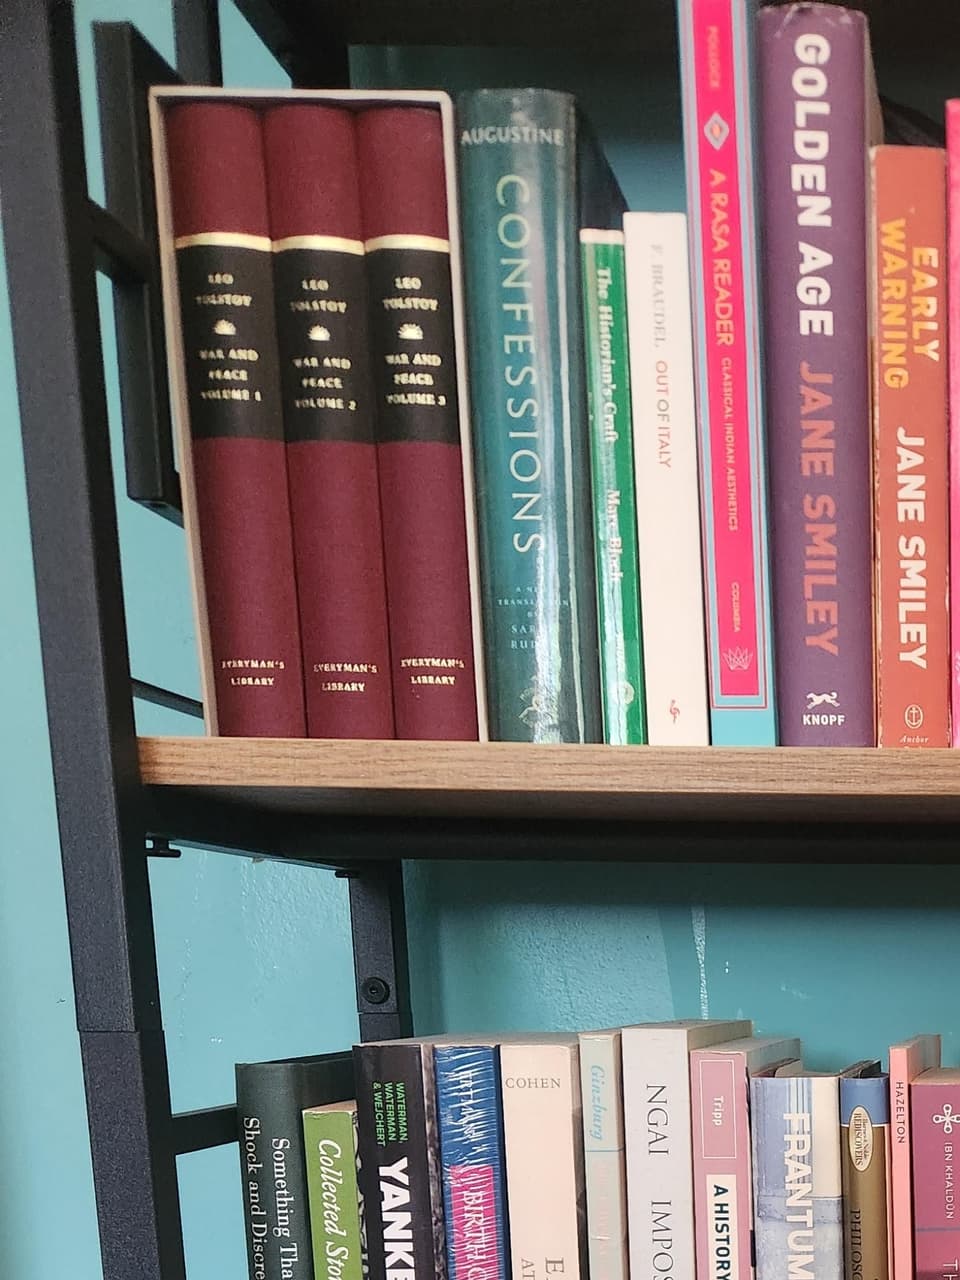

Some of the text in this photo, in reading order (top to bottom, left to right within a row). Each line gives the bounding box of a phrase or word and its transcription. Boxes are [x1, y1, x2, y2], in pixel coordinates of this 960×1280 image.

[460, 126, 565, 147] AUGUSTINE
[791, 33, 834, 336] GOLDEN AGE
[880, 218, 909, 389] WARNING
[912, 247, 939, 362] EARLY
[495, 174, 546, 553] CONFESSIONS
[800, 361, 839, 656] JANE SMILEY
[897, 427, 927, 670] JANE SMILEY
[803, 714, 845, 726] KNOPF
[384, 1082, 397, 1141] WATERMAN
[505, 1078, 561, 1089] COHEN
[646, 1083, 669, 1155] NGAI
[712, 1096, 724, 1126] Tripp
[896, 1082, 906, 1143] HAZELTON
[272, 1138, 295, 1237] Something
[318, 1139, 346, 1237] Collected
[714, 1184, 728, 1197] A
